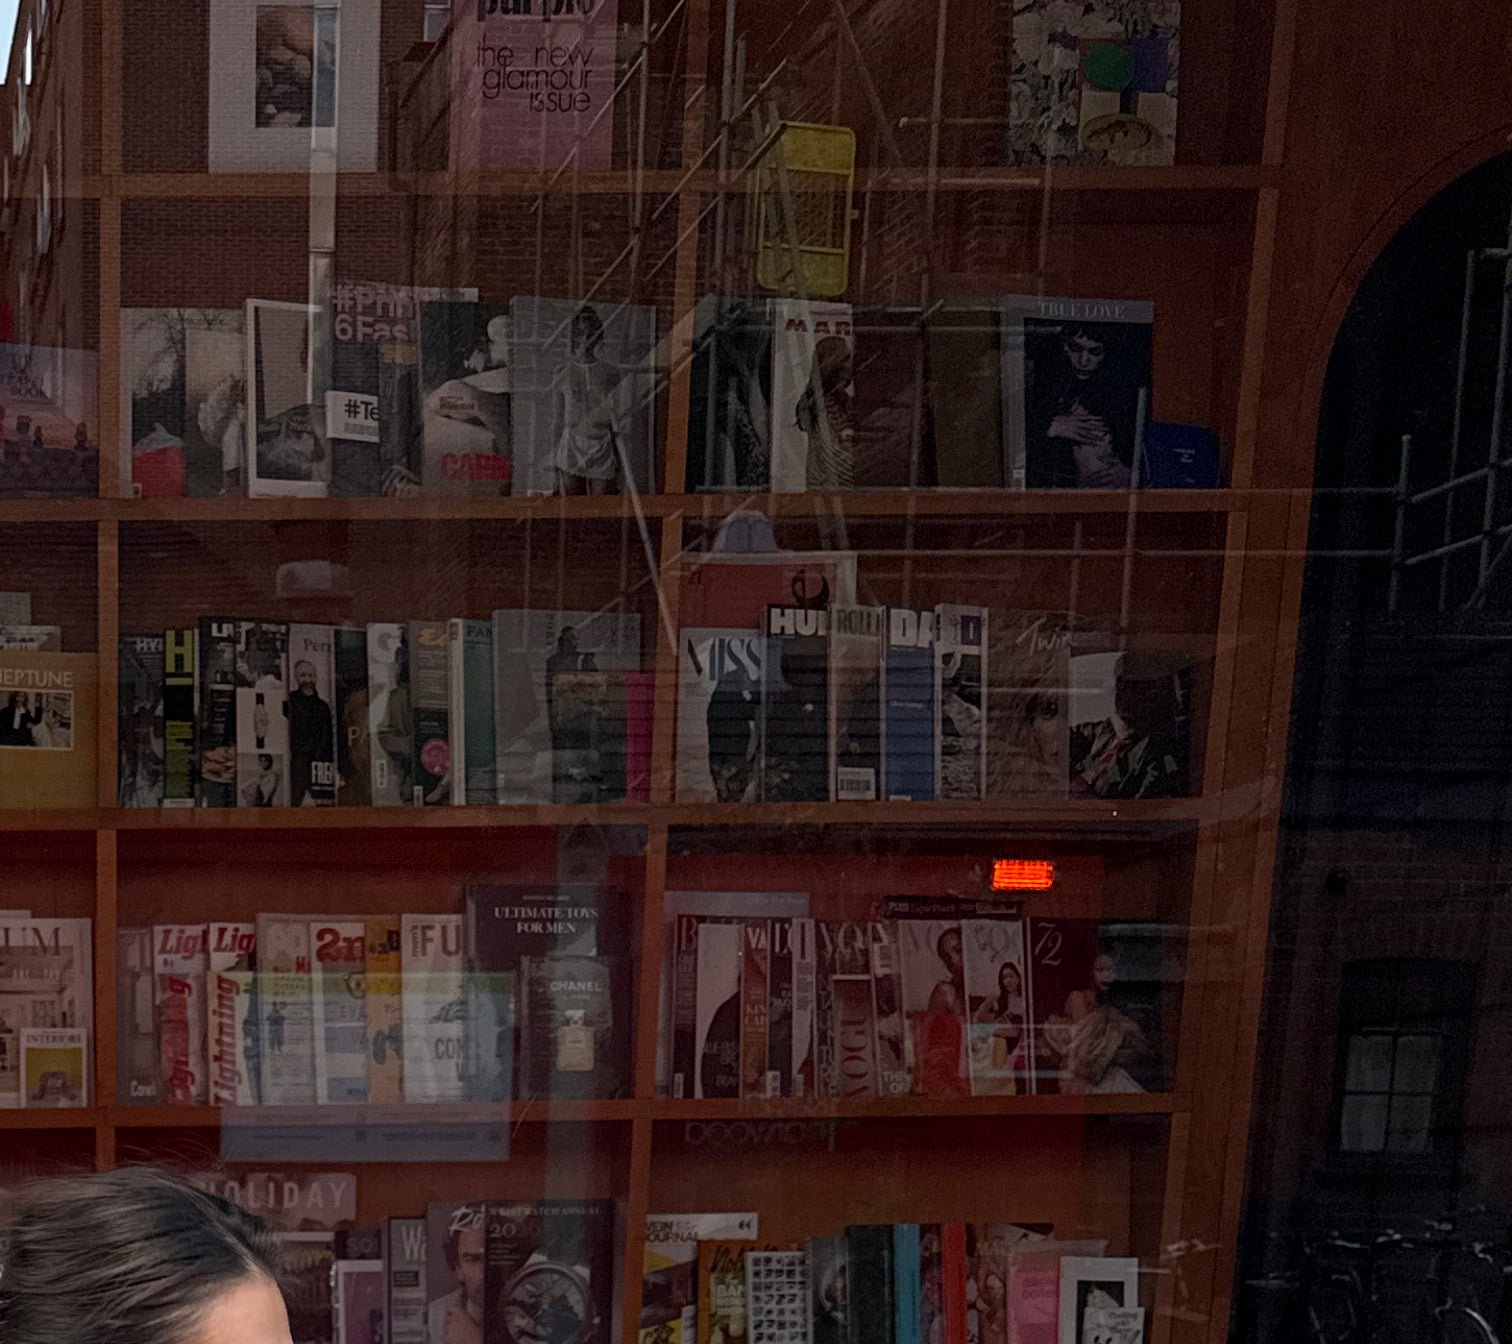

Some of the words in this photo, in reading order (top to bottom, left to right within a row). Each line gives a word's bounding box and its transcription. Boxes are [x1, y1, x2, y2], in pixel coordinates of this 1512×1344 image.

[477, 32, 514, 67] the
[535, 46, 594, 67] new
[482, 56, 593, 99] glamour
[529, 91, 591, 113] issue
[1039, 301, 1081, 318] TRUE
[1084, 302, 1127, 319] LOVE
[494, 906, 563, 920] ULTIMATE
[564, 907, 599, 920] TOYS
[516, 921, 543, 934] FOR
[545, 921, 577, 934] MEN
[1035, 923, 1063, 966] 72
[549, 980, 603, 992] CHANEL
